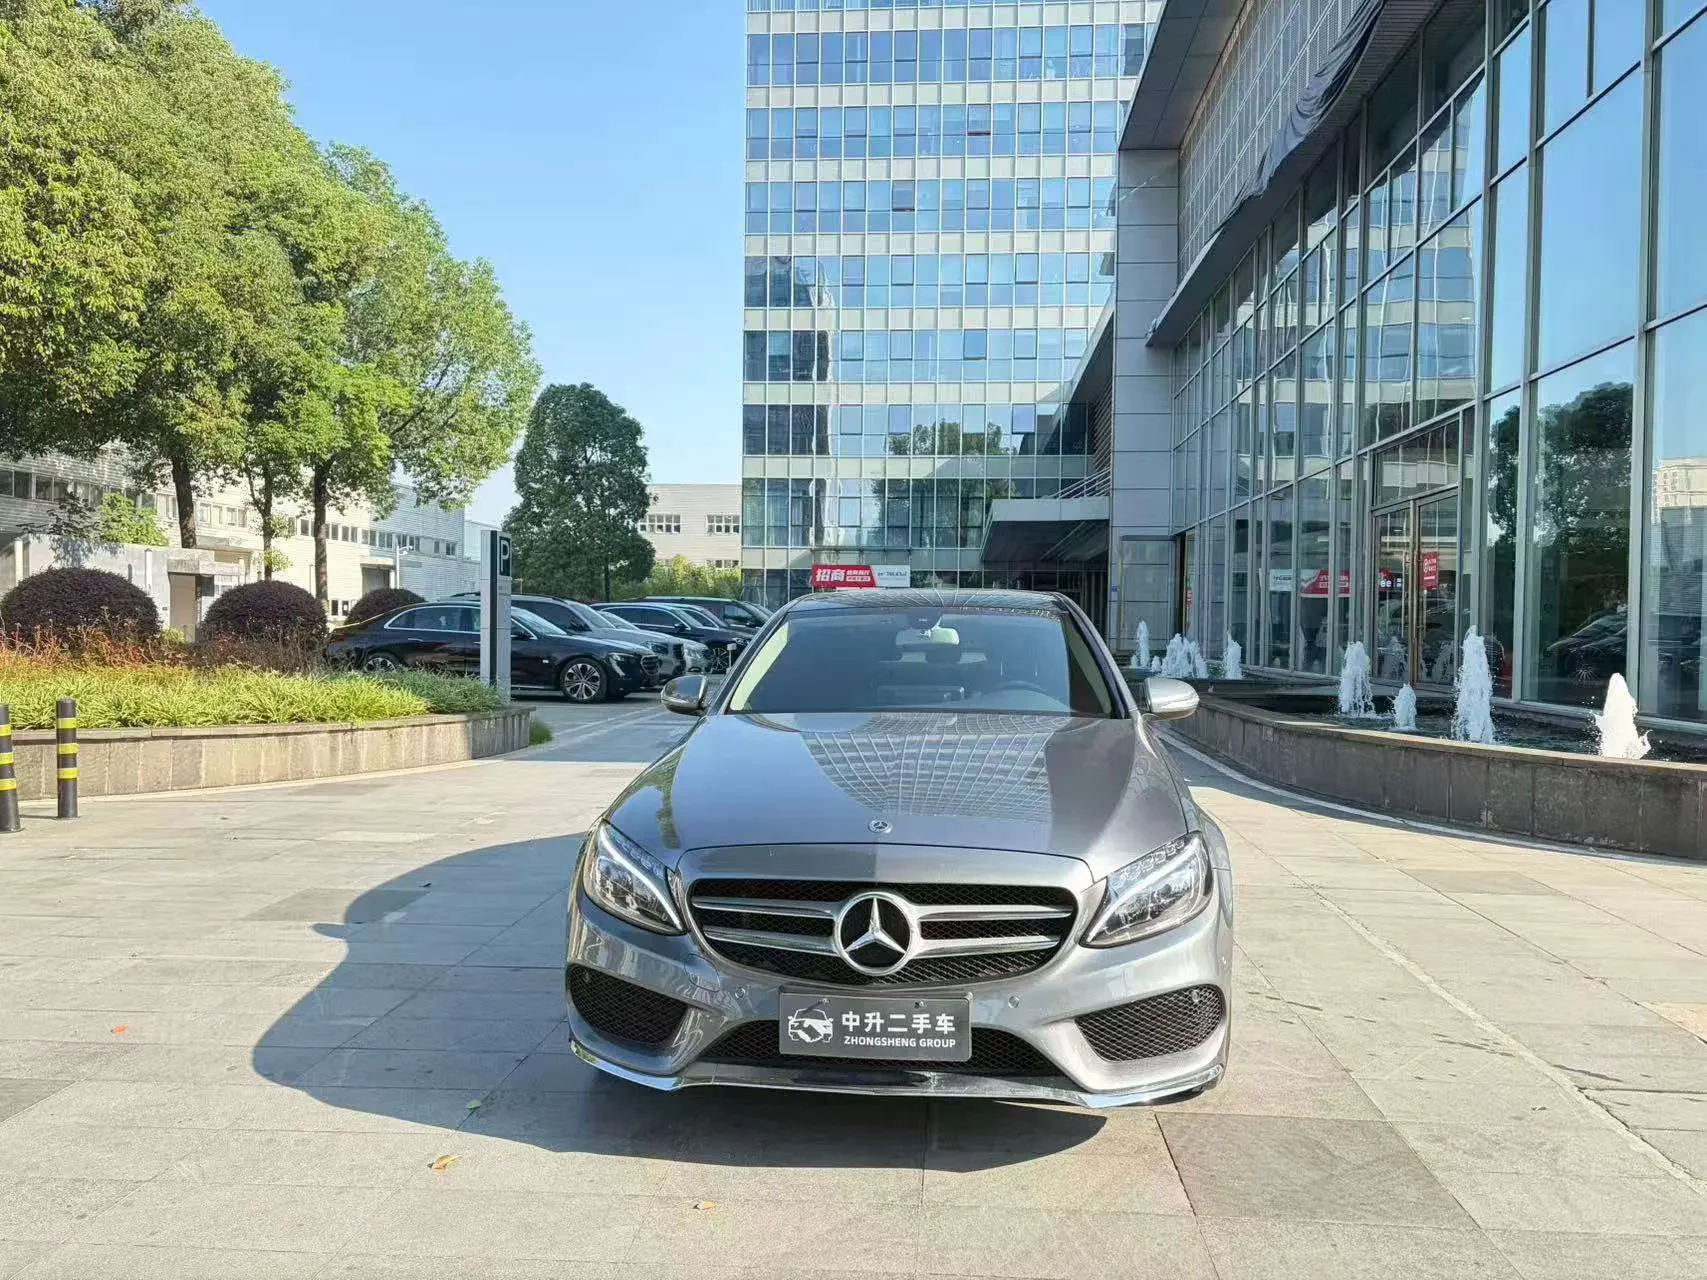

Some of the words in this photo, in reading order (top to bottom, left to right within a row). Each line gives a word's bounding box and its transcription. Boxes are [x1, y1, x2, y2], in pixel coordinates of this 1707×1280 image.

[501, 540, 510, 572] P
[817, 569, 845, 582] 招商
[842, 1011, 956, 1034] 中升二手车
[844, 1036, 916, 1047] ZHONGSHENG
[919, 1038, 956, 1048] GROUP
